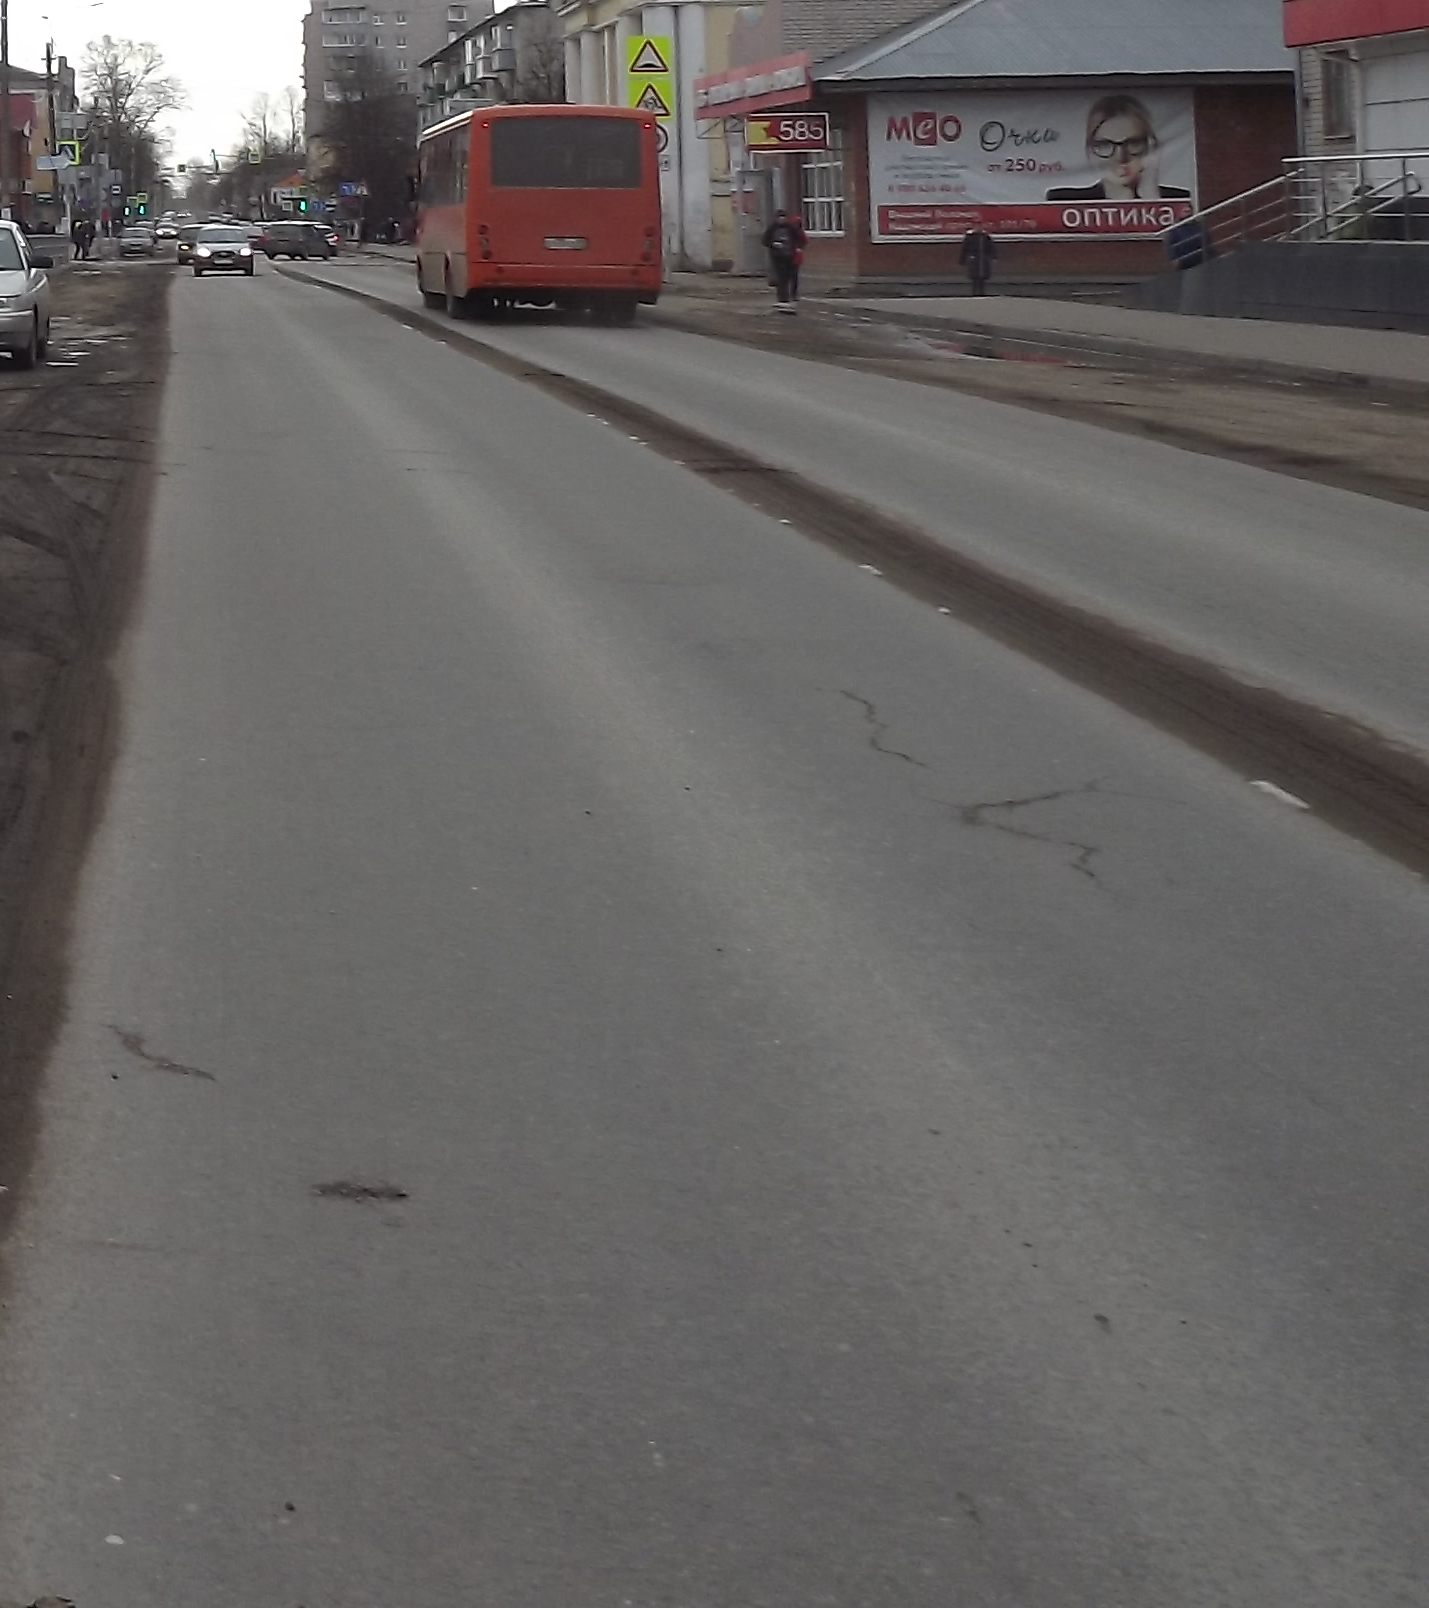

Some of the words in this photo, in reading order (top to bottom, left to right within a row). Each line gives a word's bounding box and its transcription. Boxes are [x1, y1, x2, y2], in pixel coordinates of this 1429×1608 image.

[779, 120, 823, 141] 585
[1005, 158, 1037, 173] 250
[1062, 206, 1175, 228] оптика
